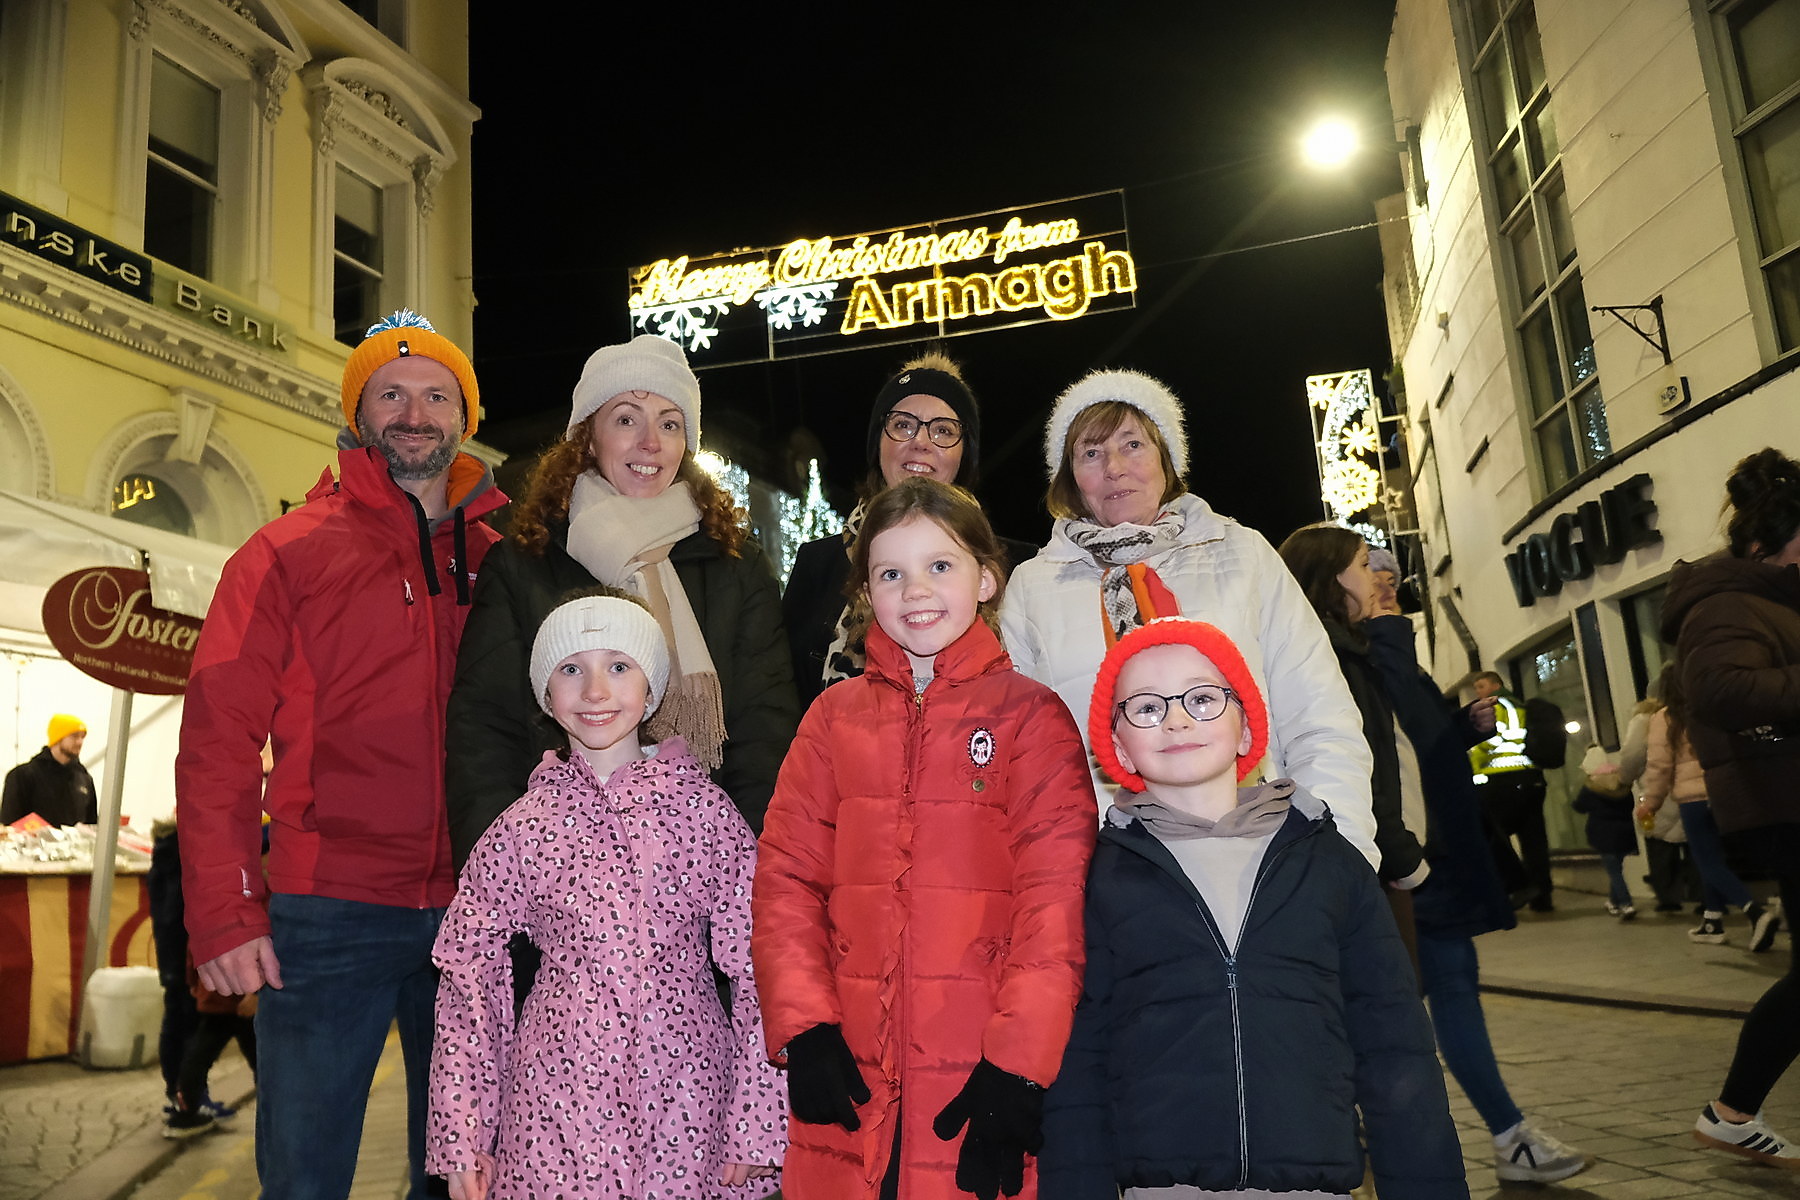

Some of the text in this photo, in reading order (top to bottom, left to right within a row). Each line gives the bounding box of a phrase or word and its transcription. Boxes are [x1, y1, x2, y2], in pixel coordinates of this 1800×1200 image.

[628, 216, 1080, 305] Merry Christmas from
[840, 241, 1137, 335] Armagh
[177, 280, 288, 352] Bank
[1503, 473, 1665, 608] VOGUE
[73, 652, 112, 671] Northern
